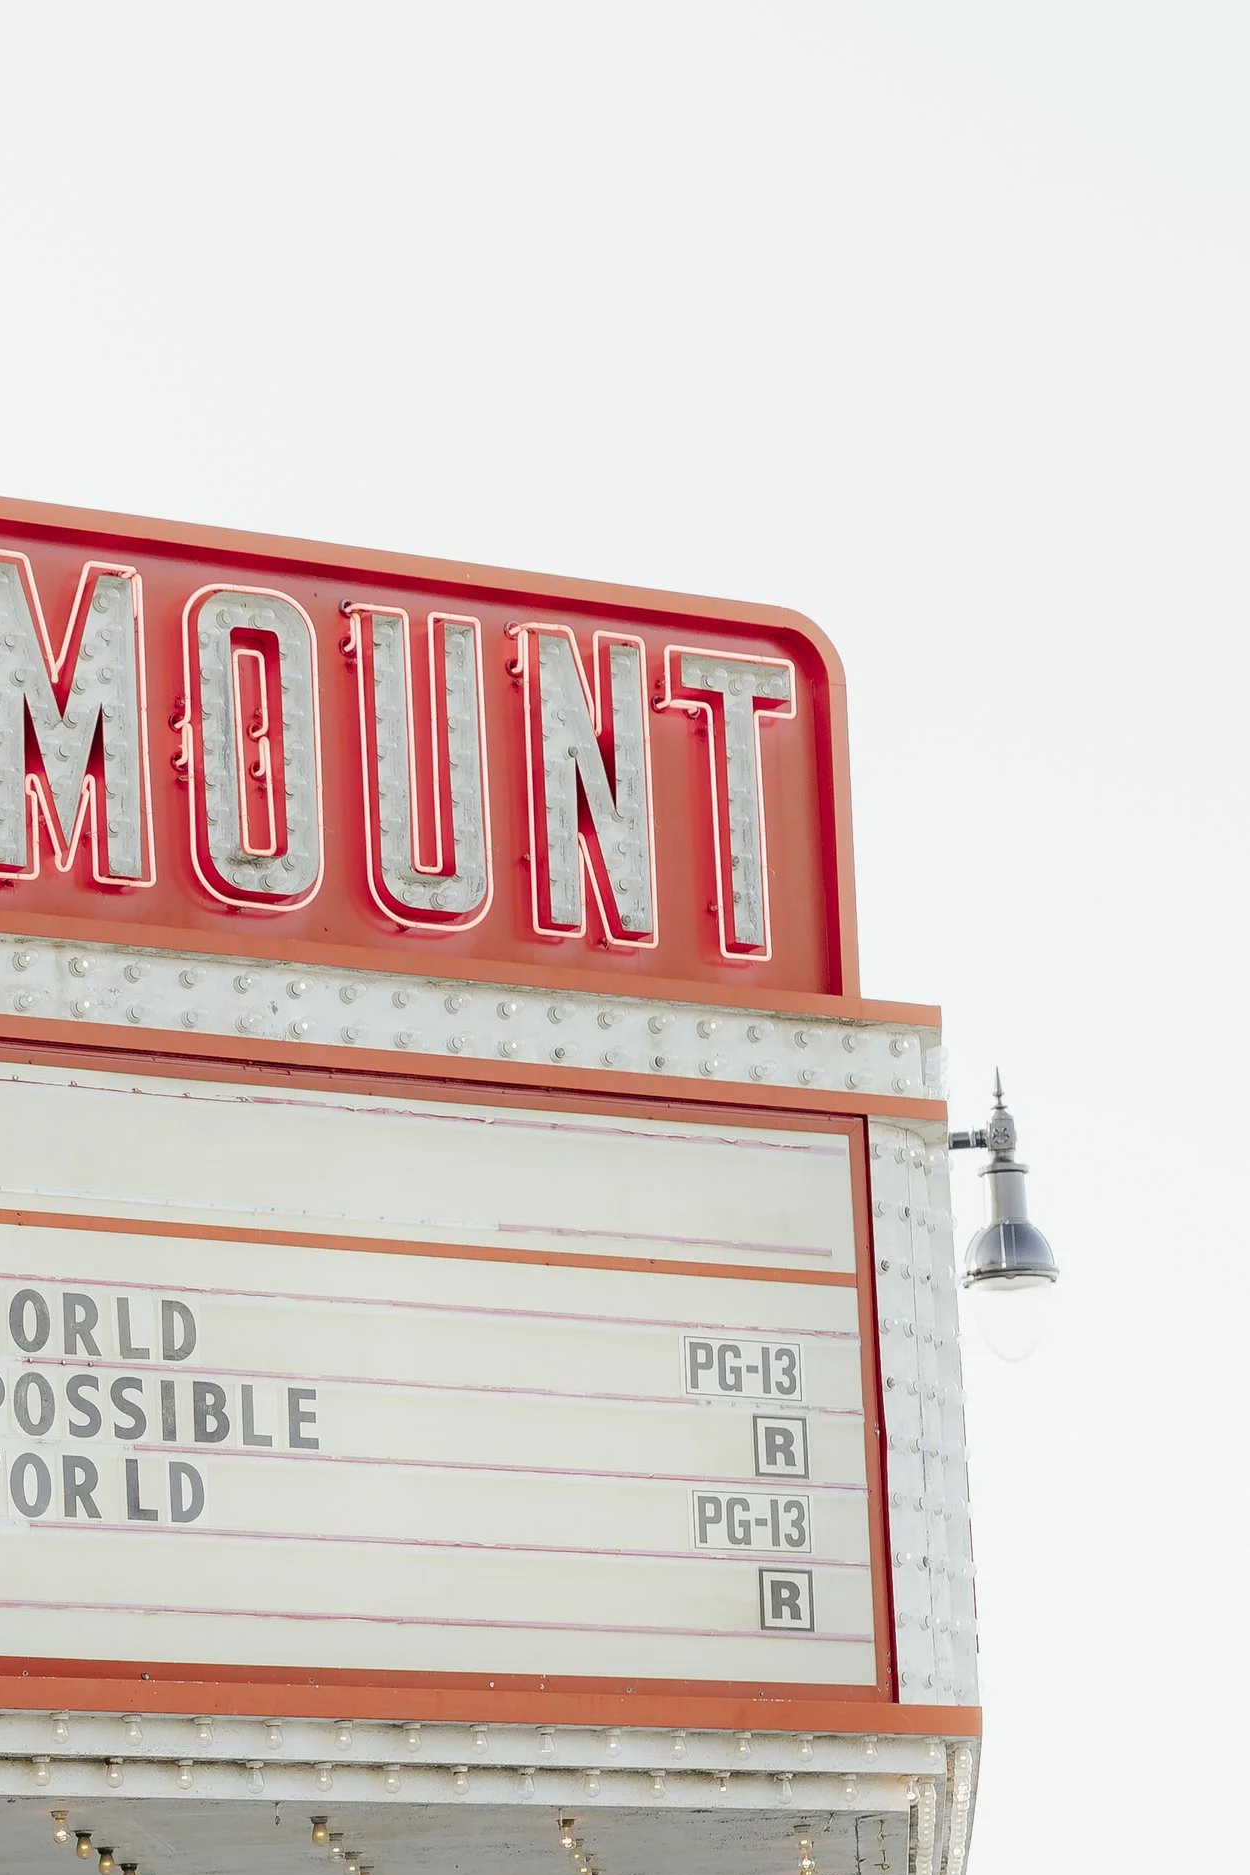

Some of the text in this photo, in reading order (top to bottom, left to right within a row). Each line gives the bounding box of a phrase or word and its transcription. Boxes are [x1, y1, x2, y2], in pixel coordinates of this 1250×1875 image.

[689, 1341, 797, 1396] PG-13
[764, 1426, 797, 1467] R
[697, 1495, 806, 1547] PG-13
[770, 1579, 803, 1621] R
